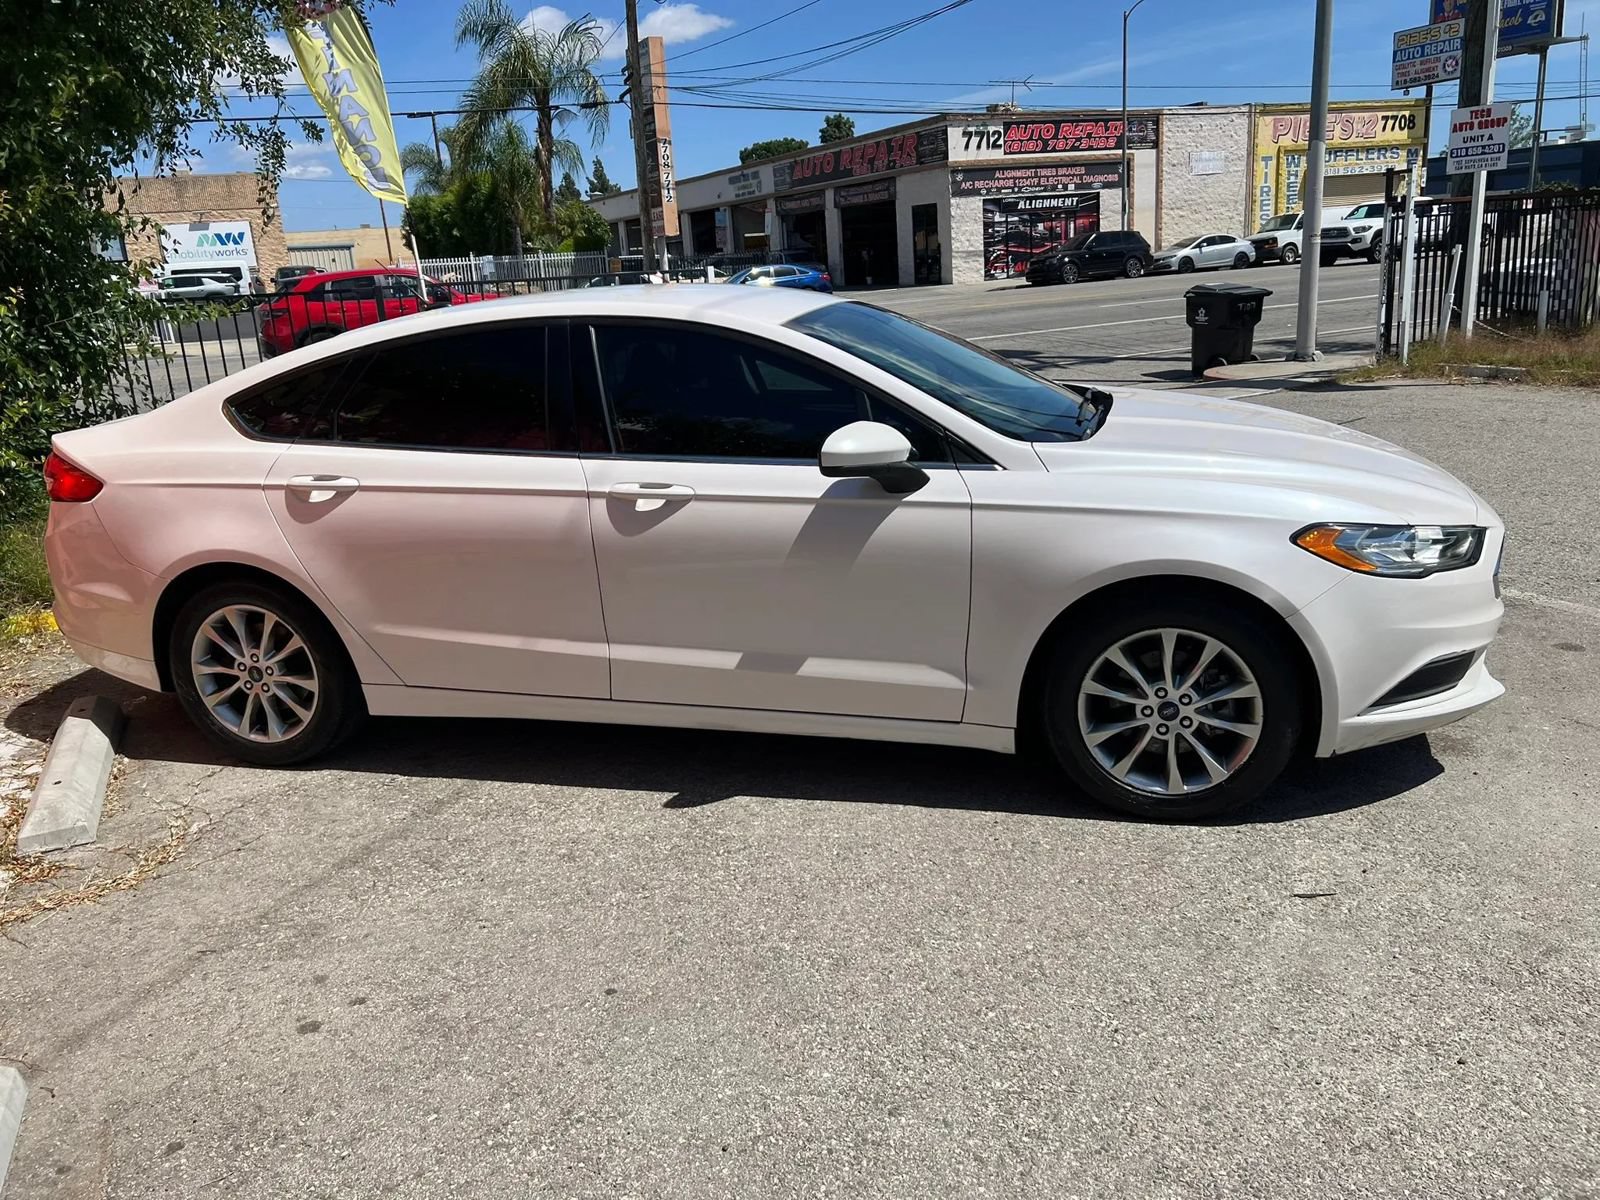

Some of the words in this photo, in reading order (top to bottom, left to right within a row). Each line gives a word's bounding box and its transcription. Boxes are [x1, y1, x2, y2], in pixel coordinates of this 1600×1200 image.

[1499, 9, 1523, 28] acob
[1397, 27, 1441, 48] PIBE'S
[1395, 47, 1421, 61] AUTO
[1424, 39, 1461, 56] REPAIR
[1470, 108, 1492, 120] TECH
[1004, 123, 1055, 141] AUTO
[1381, 114, 1416, 133] 7708
[1452, 121, 1475, 133] AUTO
[1478, 117, 1508, 129] GROUP
[962, 130, 1003, 151] 7712
[1004, 139, 1043, 152] (818)
[1046, 137, 1117, 151] 787-3492
[1463, 134, 1485, 143] UNIT
[1487, 133, 1494, 141] A
[660, 138, 670, 169] 7708
[792, 152, 834, 180] AUTO
[840, 133, 917, 170] REPAIR
[1325, 147, 1401, 164] UFFLERS
[1452, 147, 1466, 157] 310
[960, 180, 973, 189] A/C
[974, 178, 1014, 188] RECHARGE
[1015, 178, 1039, 186] 1234YF
[1040, 176, 1082, 185] ELECTRICAL
[1083, 173, 1118, 183] DIAGNOSIS
[994, 169, 1036, 178] ALIGNMENT
[1037, 168, 1057, 176] TIRES
[1058, 166, 1085, 175] BRAKES
[663, 172, 673, 203] 7712
[1260, 156, 1273, 223] TIRES
[1286, 155, 1301, 213] WHEE
[1017, 197, 1079, 209] ALIGNMENT
